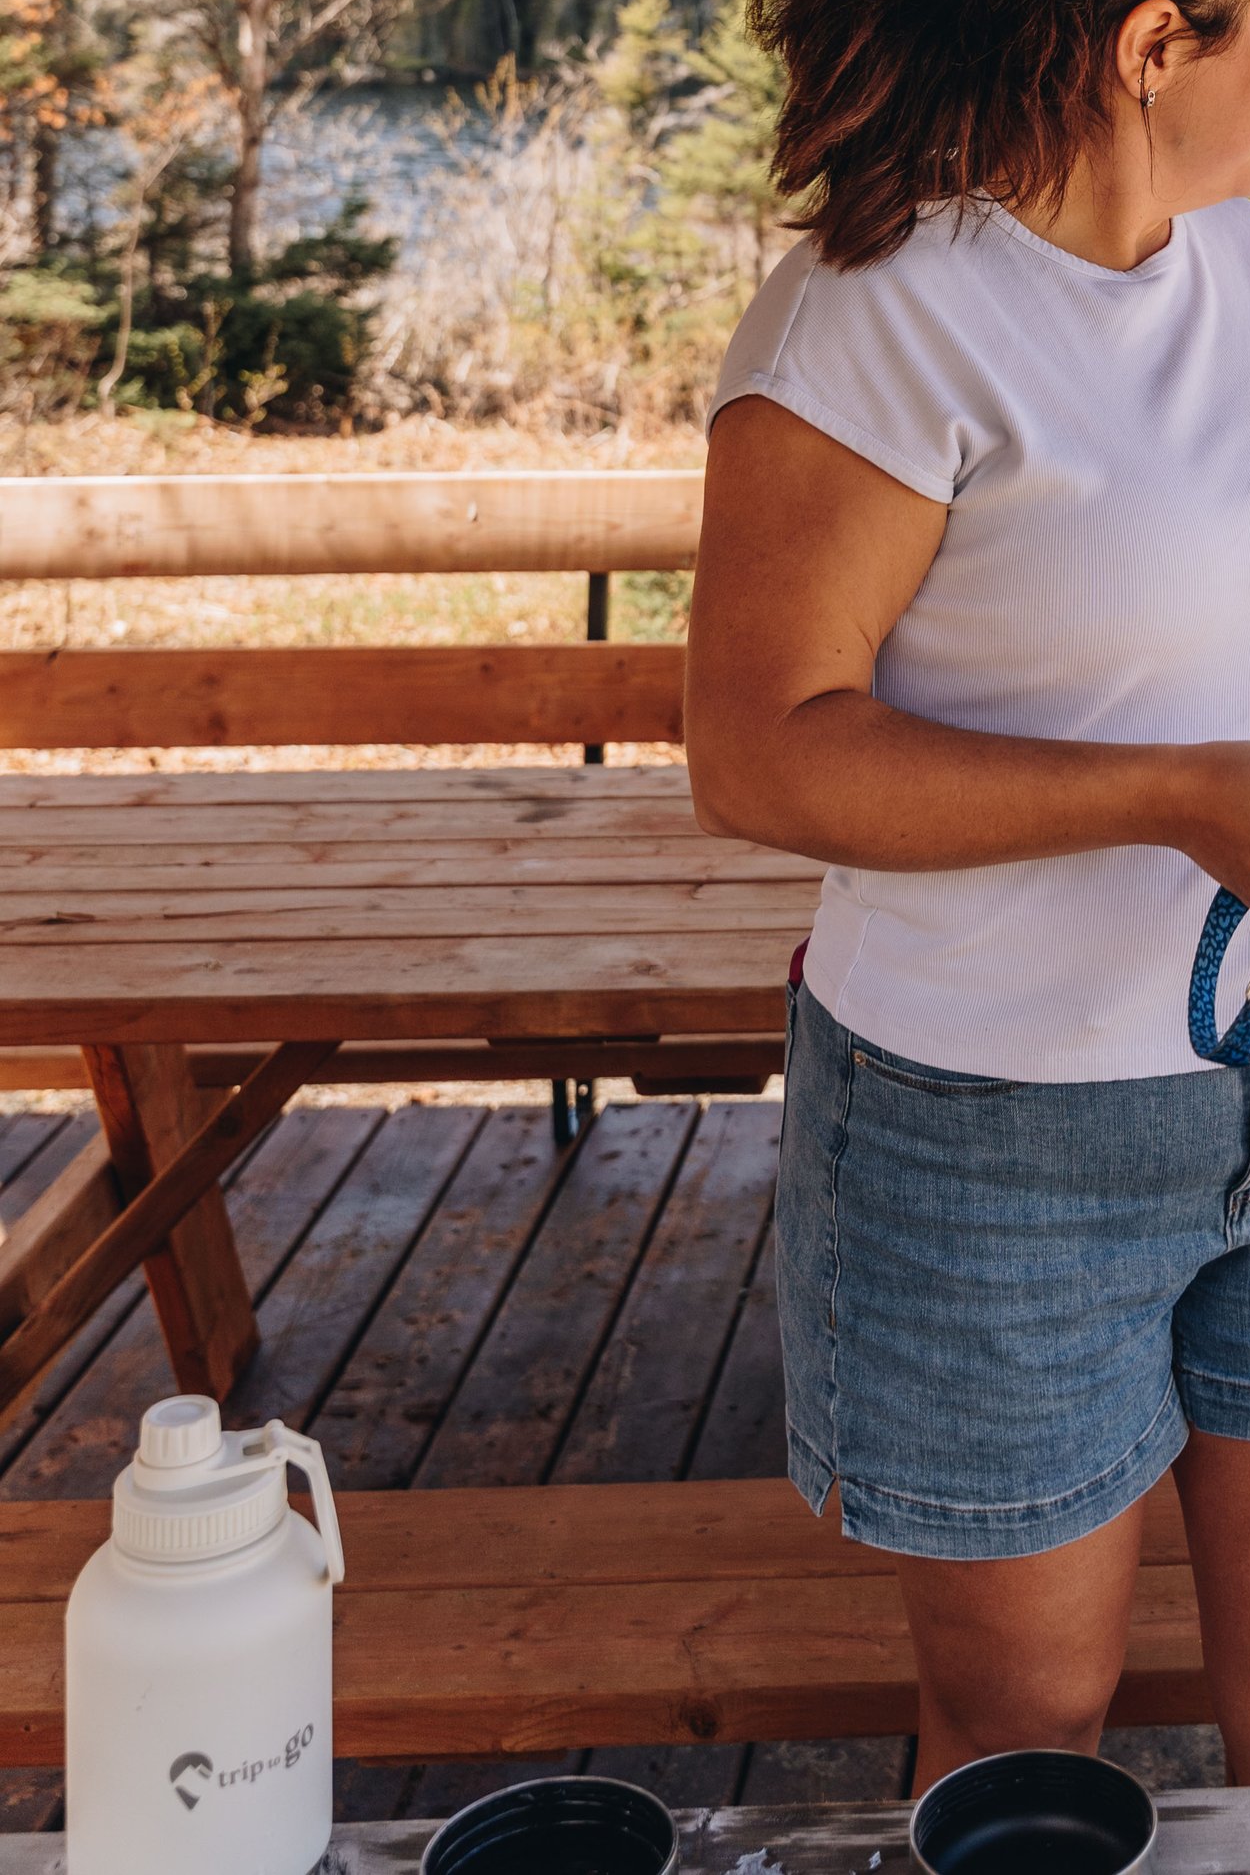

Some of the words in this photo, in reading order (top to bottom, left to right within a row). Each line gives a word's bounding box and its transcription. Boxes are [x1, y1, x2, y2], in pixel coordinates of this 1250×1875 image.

[218, 1760, 264, 1787] trip
[267, 1756, 281, 1769] to
[284, 1723, 314, 1768] go
